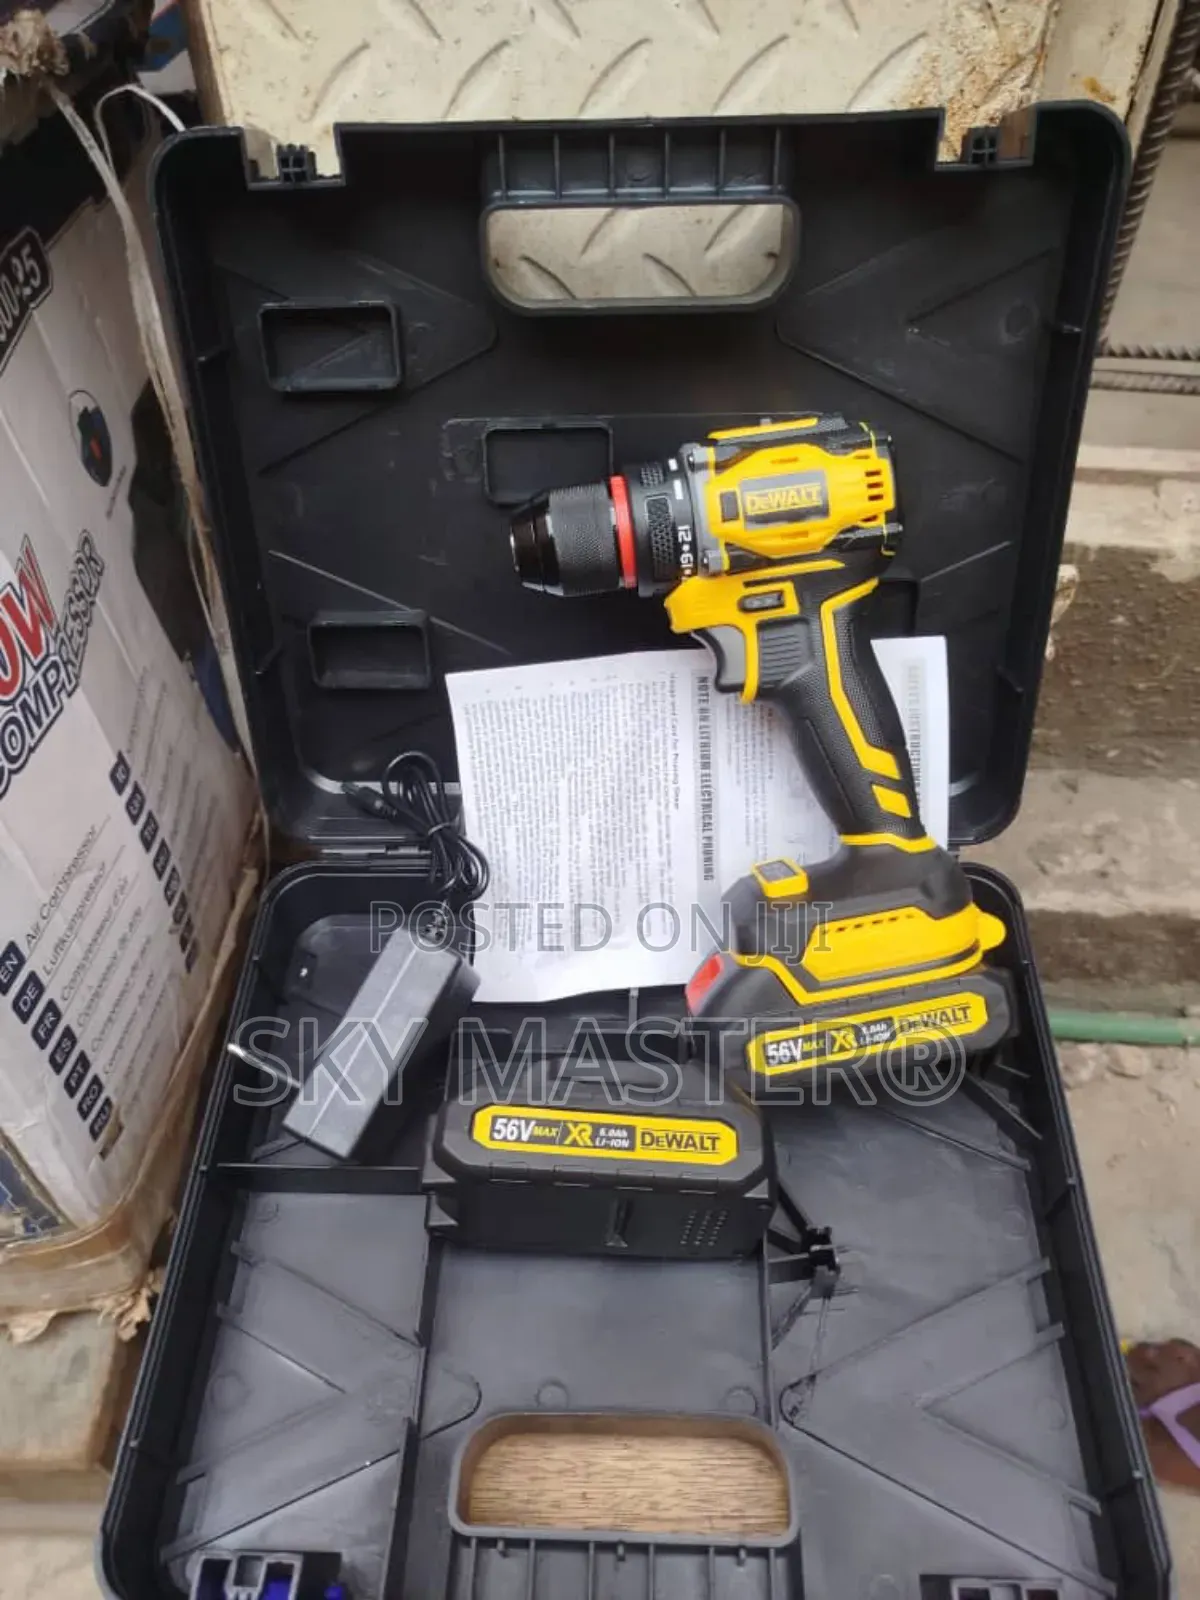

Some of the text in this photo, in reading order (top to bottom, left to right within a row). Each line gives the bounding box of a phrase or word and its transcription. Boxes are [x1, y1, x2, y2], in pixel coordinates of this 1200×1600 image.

[697, 676, 710, 705] NOTE
[700, 772, 713, 833] ELECTRICAL
[0, 953, 19, 985] EN
[25, 921, 41, 949] Air
[19, 984, 39, 1013] DE
[37, 1011, 57, 1041] FR
[56, 1037, 72, 1063] ES
[766, 1038, 802, 1065] 56V
[492, 1117, 594, 1147] 56V MAX XR
[640, 1130, 721, 1151] DEWALT
